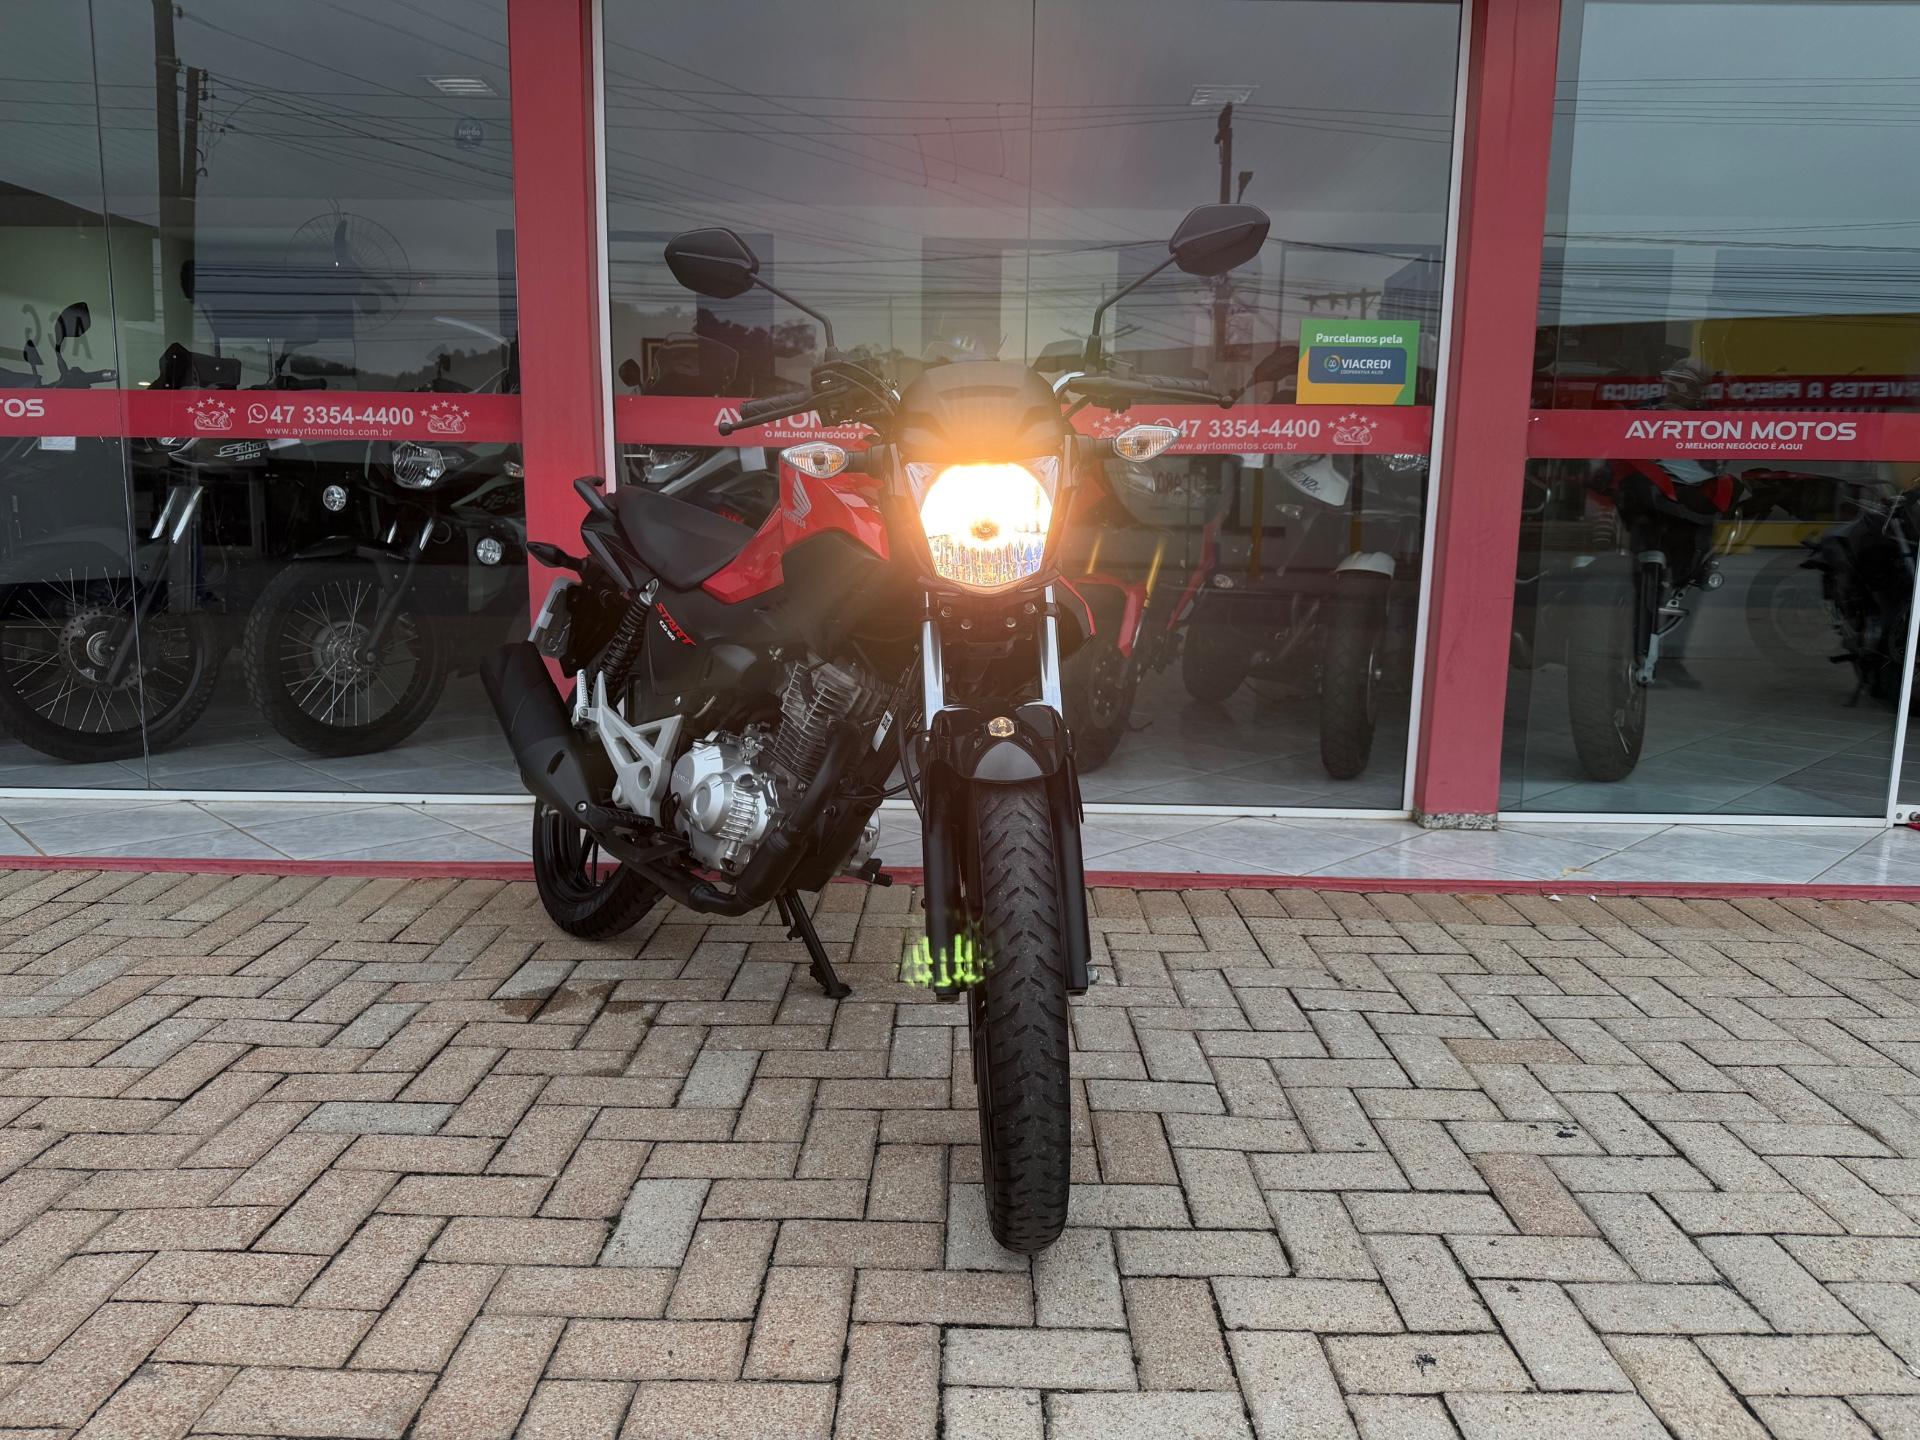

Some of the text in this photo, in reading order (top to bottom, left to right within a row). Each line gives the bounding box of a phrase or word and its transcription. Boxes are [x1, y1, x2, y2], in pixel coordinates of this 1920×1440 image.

[1315, 333, 1403, 346] Parcelamos pela
[1341, 359, 1391, 370] VIACREDI
[270, 405, 415, 426] 47 3354-4400
[265, 427, 393, 438] www.ayrtonmotos.com.br
[814, 430, 857, 439] NEGÓCIO
[1179, 419, 1321, 438] 47 3354-4400
[1625, 420, 1857, 441] AYRTON MOTOS
[1675, 442, 1684, 450] O
[1685, 442, 1725, 450] MELHOR
[1726, 441, 1769, 451] NEGÓCIO
